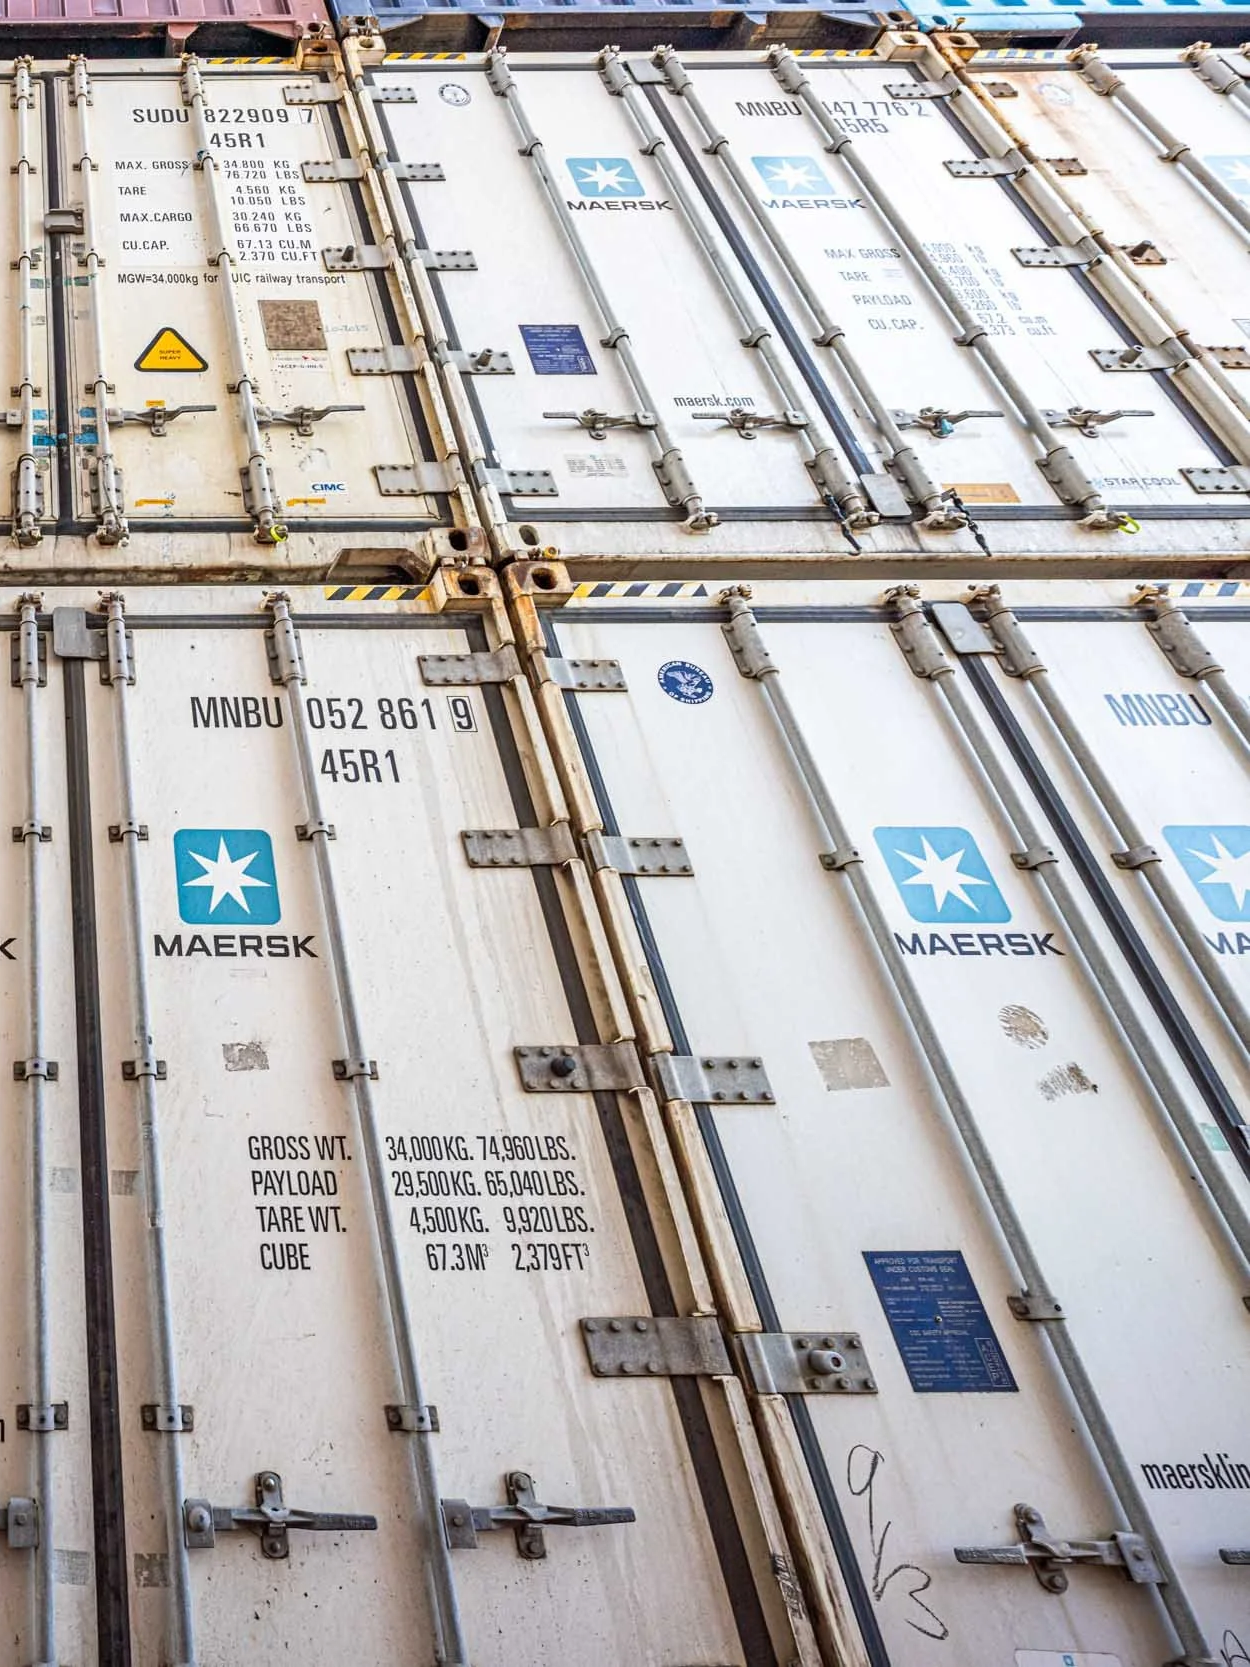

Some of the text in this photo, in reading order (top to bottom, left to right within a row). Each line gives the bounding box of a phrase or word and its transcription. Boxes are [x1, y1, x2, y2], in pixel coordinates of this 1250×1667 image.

[735, 101, 931, 117] MNBU 776 2
[133, 108, 313, 124] SUDU 822909 7
[210, 132, 266, 148] 45R1
[115, 161, 189, 170] MAX. GROSS
[273, 160, 290, 169] KG
[276, 170, 300, 180] LBS
[118, 186, 147, 196] TARE
[279, 186, 296, 195] KG
[281, 196, 306, 206] LBS
[567, 200, 674, 211] MAERSK
[285, 212, 302, 221] KG
[287, 223, 312, 233] LBS
[279, 239, 312, 249] CU.M
[281, 251, 318, 261] CU.FT
[859, 248, 901, 258] GROSS
[203, 273, 219, 283] for
[231, 273, 251, 283] UIC
[255, 273, 292, 286] railway
[296, 274, 346, 286] transport
[839, 271, 871, 282] TARE
[852, 294, 912, 305] PAYLOAD
[673, 394, 755, 407] maersk.com
[312, 483, 346, 491] CIMC
[1105, 477, 1181, 486] STAR COOL
[190, 696, 475, 731] MNBU 052 861 9
[1103, 693, 1212, 726] MNBU
[320, 749, 401, 783] 45R1
[153, 934, 319, 958] MAERSK
[894, 933, 1066, 956] MAERSK
[248, 1136, 311, 1161] GROSS
[314, 1136, 352, 1161] WT.
[251, 1170, 338, 1196] PAYLOAD
[255, 1206, 305, 1233] TARE
[310, 1206, 347, 1233] WT.
[259, 1243, 311, 1271] CUBE
